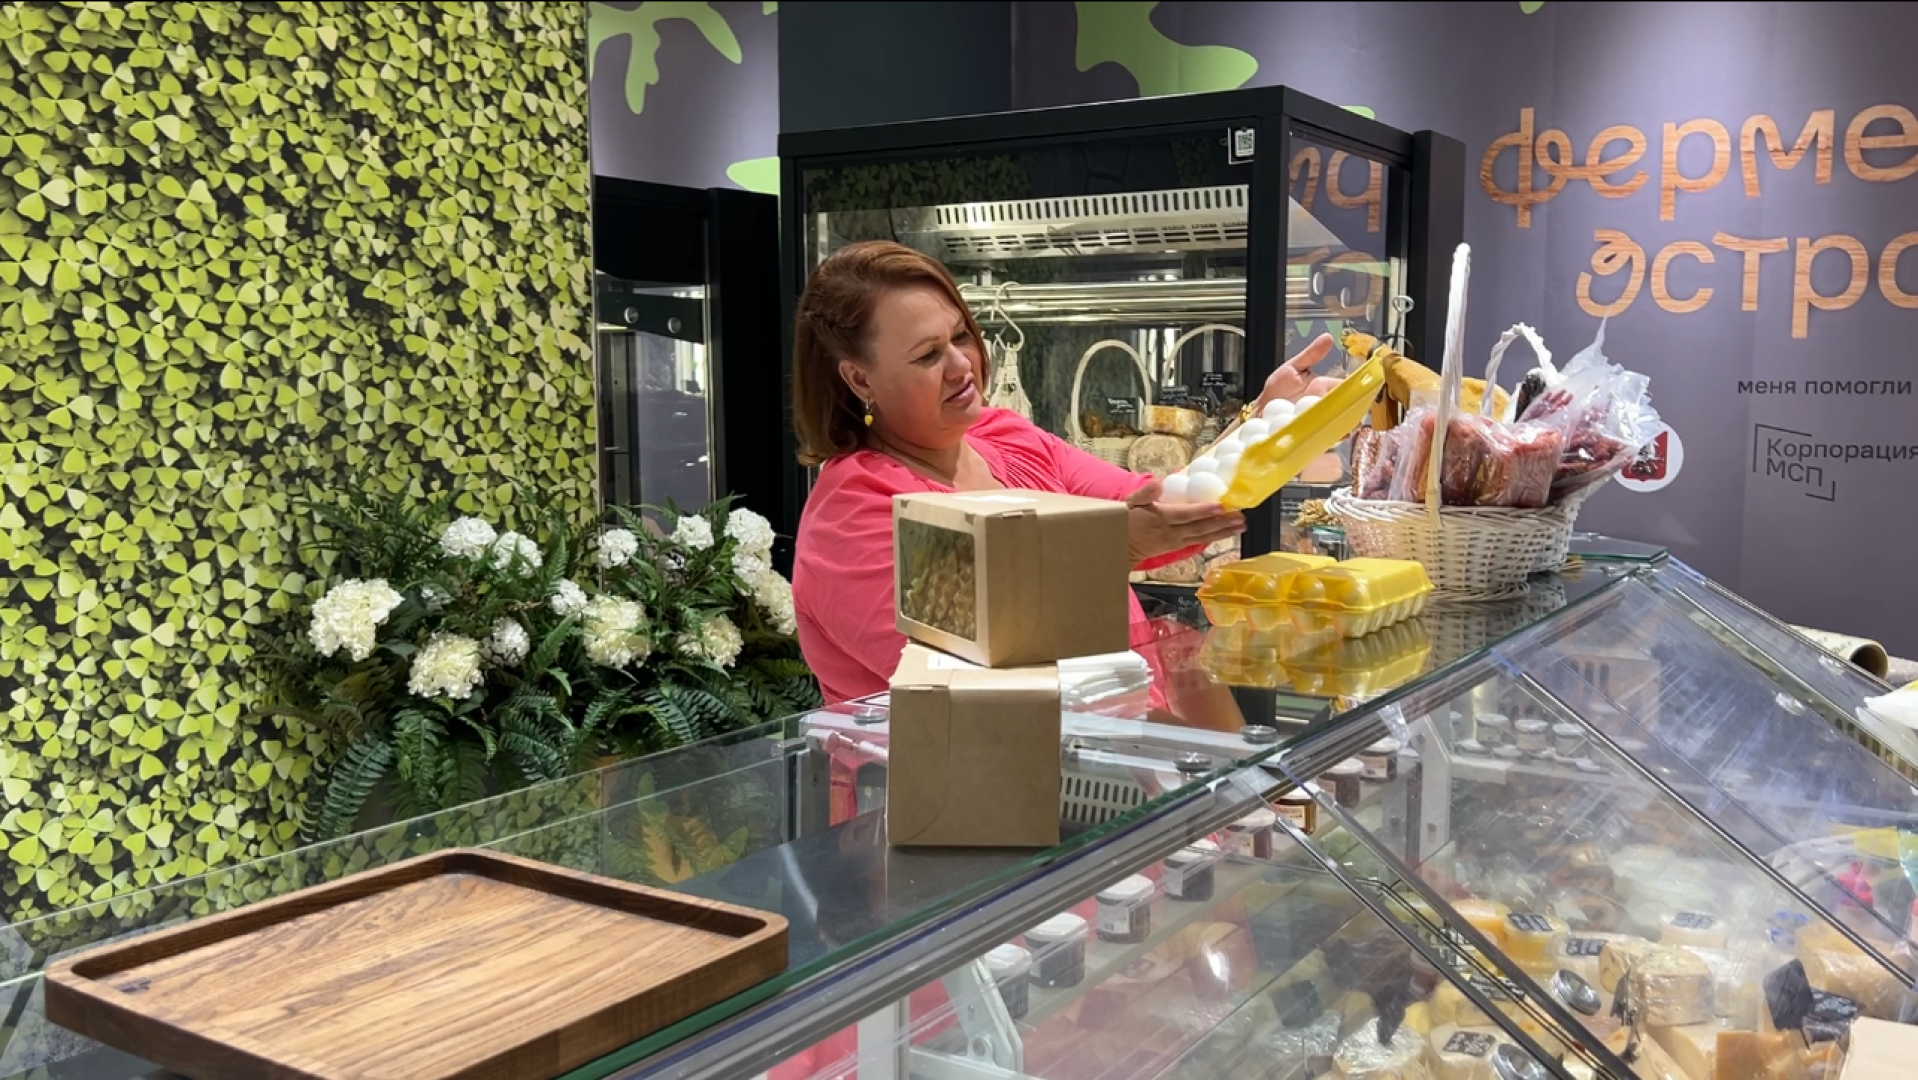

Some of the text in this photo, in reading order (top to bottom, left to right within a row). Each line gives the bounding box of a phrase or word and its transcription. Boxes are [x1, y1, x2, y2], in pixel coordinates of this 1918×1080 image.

[1737, 380, 1913, 395] меня помогли
[1766, 438, 1918, 464] Корпорация
[1766, 457, 1823, 488] МСП
